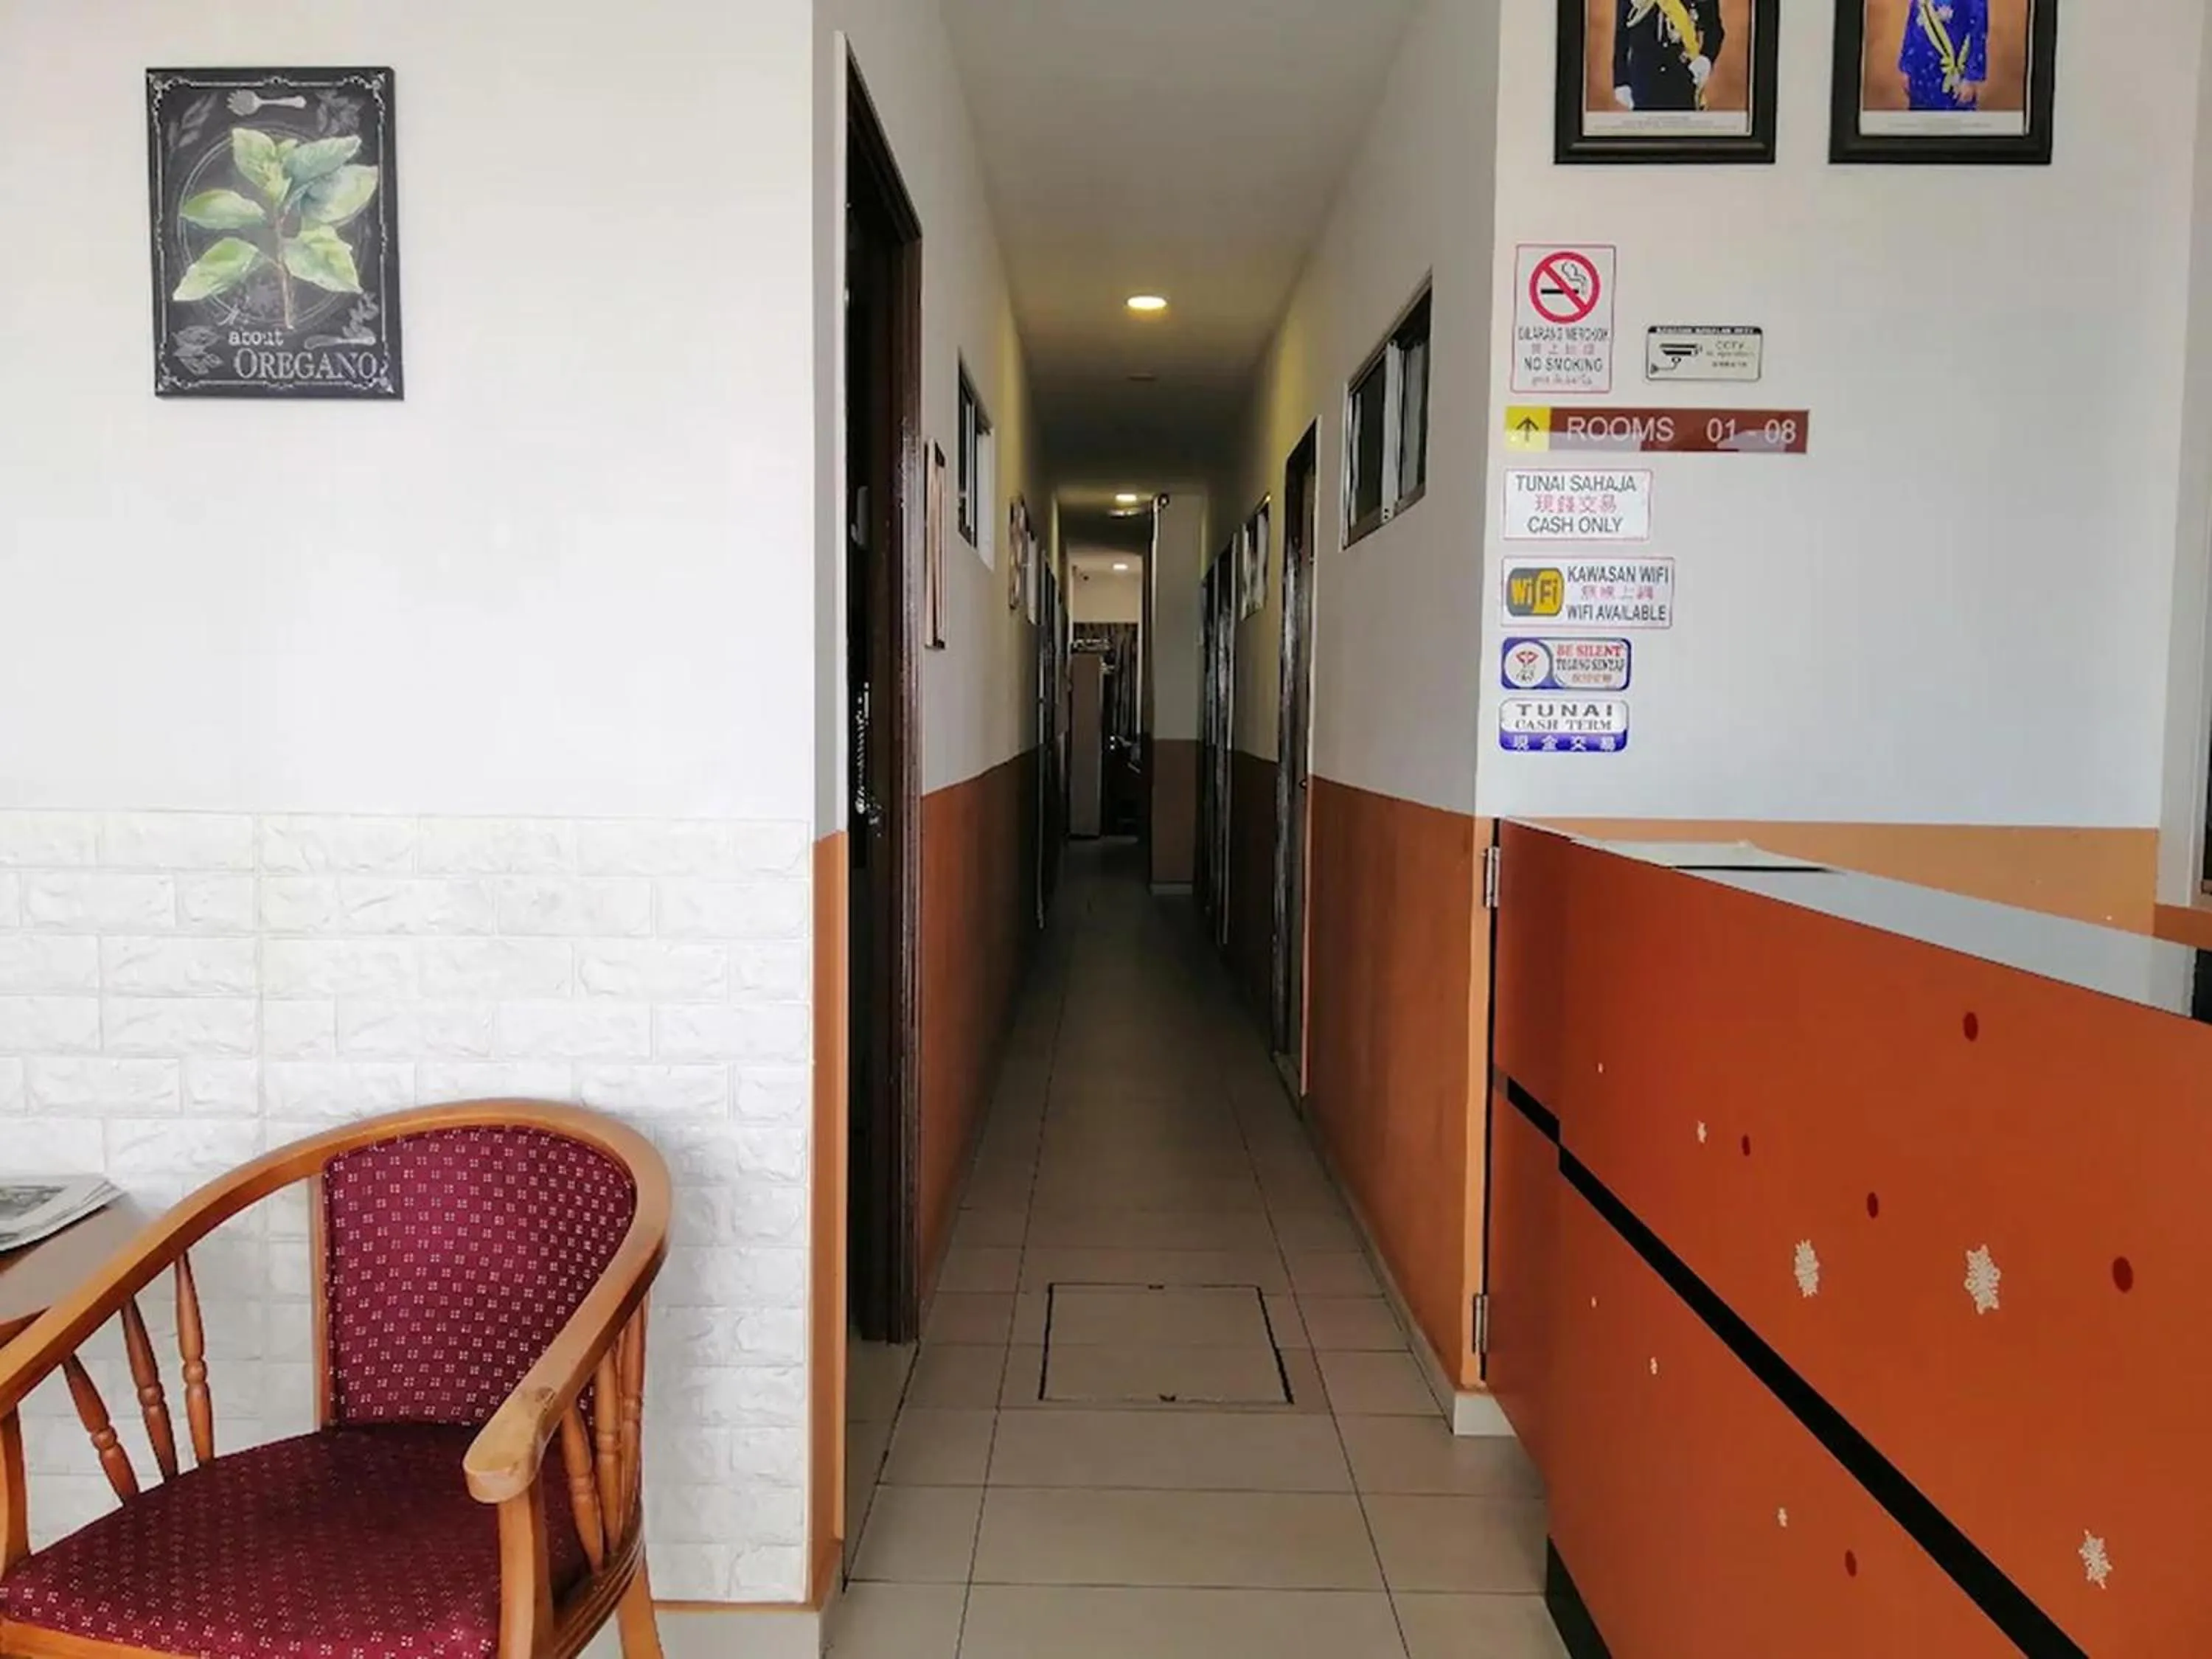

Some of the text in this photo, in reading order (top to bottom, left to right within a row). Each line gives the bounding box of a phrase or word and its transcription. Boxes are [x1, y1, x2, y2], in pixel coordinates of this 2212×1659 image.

[234, 348, 378, 379] OREGANO
[1524, 357, 1603, 372] NO SMOKING
[1568, 417, 1674, 441] ROOMS
[1707, 417, 1736, 442] 01
[1764, 419, 1797, 444] 08
[1516, 475, 1636, 492] TUNAI SAHAJA
[1527, 516, 1624, 533] CASH ONLY
[1567, 566, 1669, 584] KAWASAN WIFI
[1567, 605, 1666, 621] WIFI AVAILABLE
[1576, 644, 1621, 657] SILENT
[1516, 703, 1613, 717] TUNAI
[1515, 720, 1612, 731] CASH TERM
